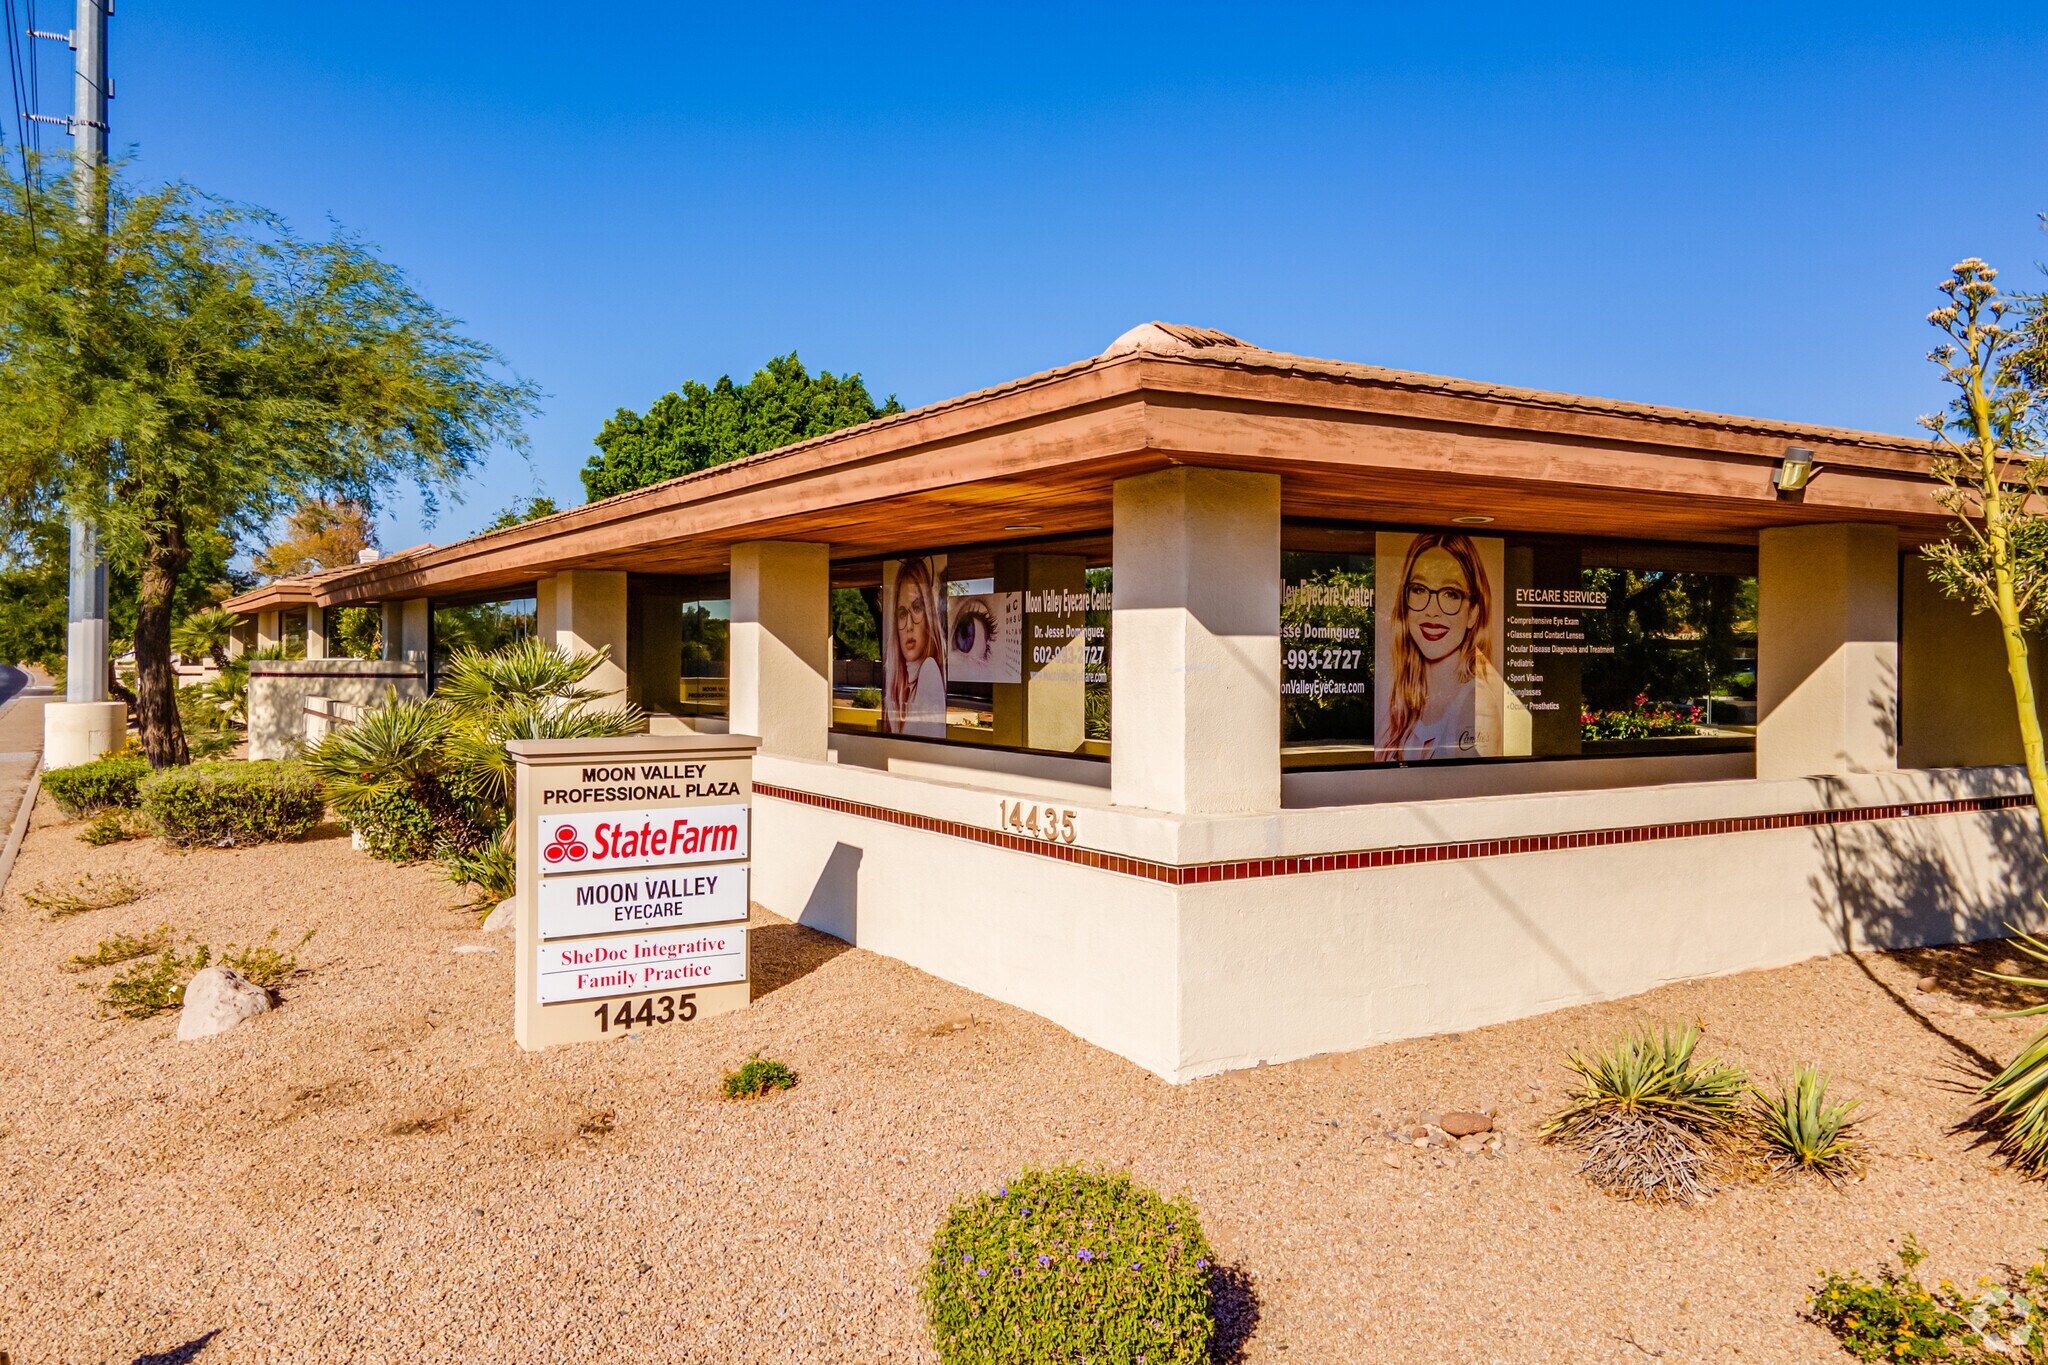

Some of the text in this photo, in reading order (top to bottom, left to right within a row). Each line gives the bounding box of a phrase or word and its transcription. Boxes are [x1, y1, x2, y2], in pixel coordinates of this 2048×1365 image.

[1043, 589, 1063, 618] Valley
[1063, 588, 1090, 618] Eyecare
[1280, 579, 1375, 612] lley Eyecare Center
[1516, 588, 1607, 604] EYECARE SERVICES
[1034, 625, 1044, 638] Dr.
[1044, 625, 1064, 638] Jesse
[1510, 616, 1580, 627] Comprehensive Eye Exam
[1280, 623, 1361, 642] esse Dominguez
[1510, 631, 1585, 640] Glasses and Contact Lenses
[1282, 649, 1361, 670] -993-2727
[1510, 645, 1615, 655] Ocular Disease Diagnosis and Treatment
[1510, 659, 1535, 668] Pediatric
[1510, 674, 1544, 683] Sport Vision
[1529, 701, 1560, 711] Prosthetics
[581, 764, 707, 783] MOON VALLEY
[543, 782, 740, 805] PROFESSIONAL PLAZA
[999, 799, 1078, 845] 14435
[576, 876, 719, 906] MOON VALLEY
[614, 901, 683, 922] EYECARE
[561, 937, 726, 967] SheDoc Integrative
[577, 963, 712, 990] Family Practice
[594, 992, 698, 1033] 14435
